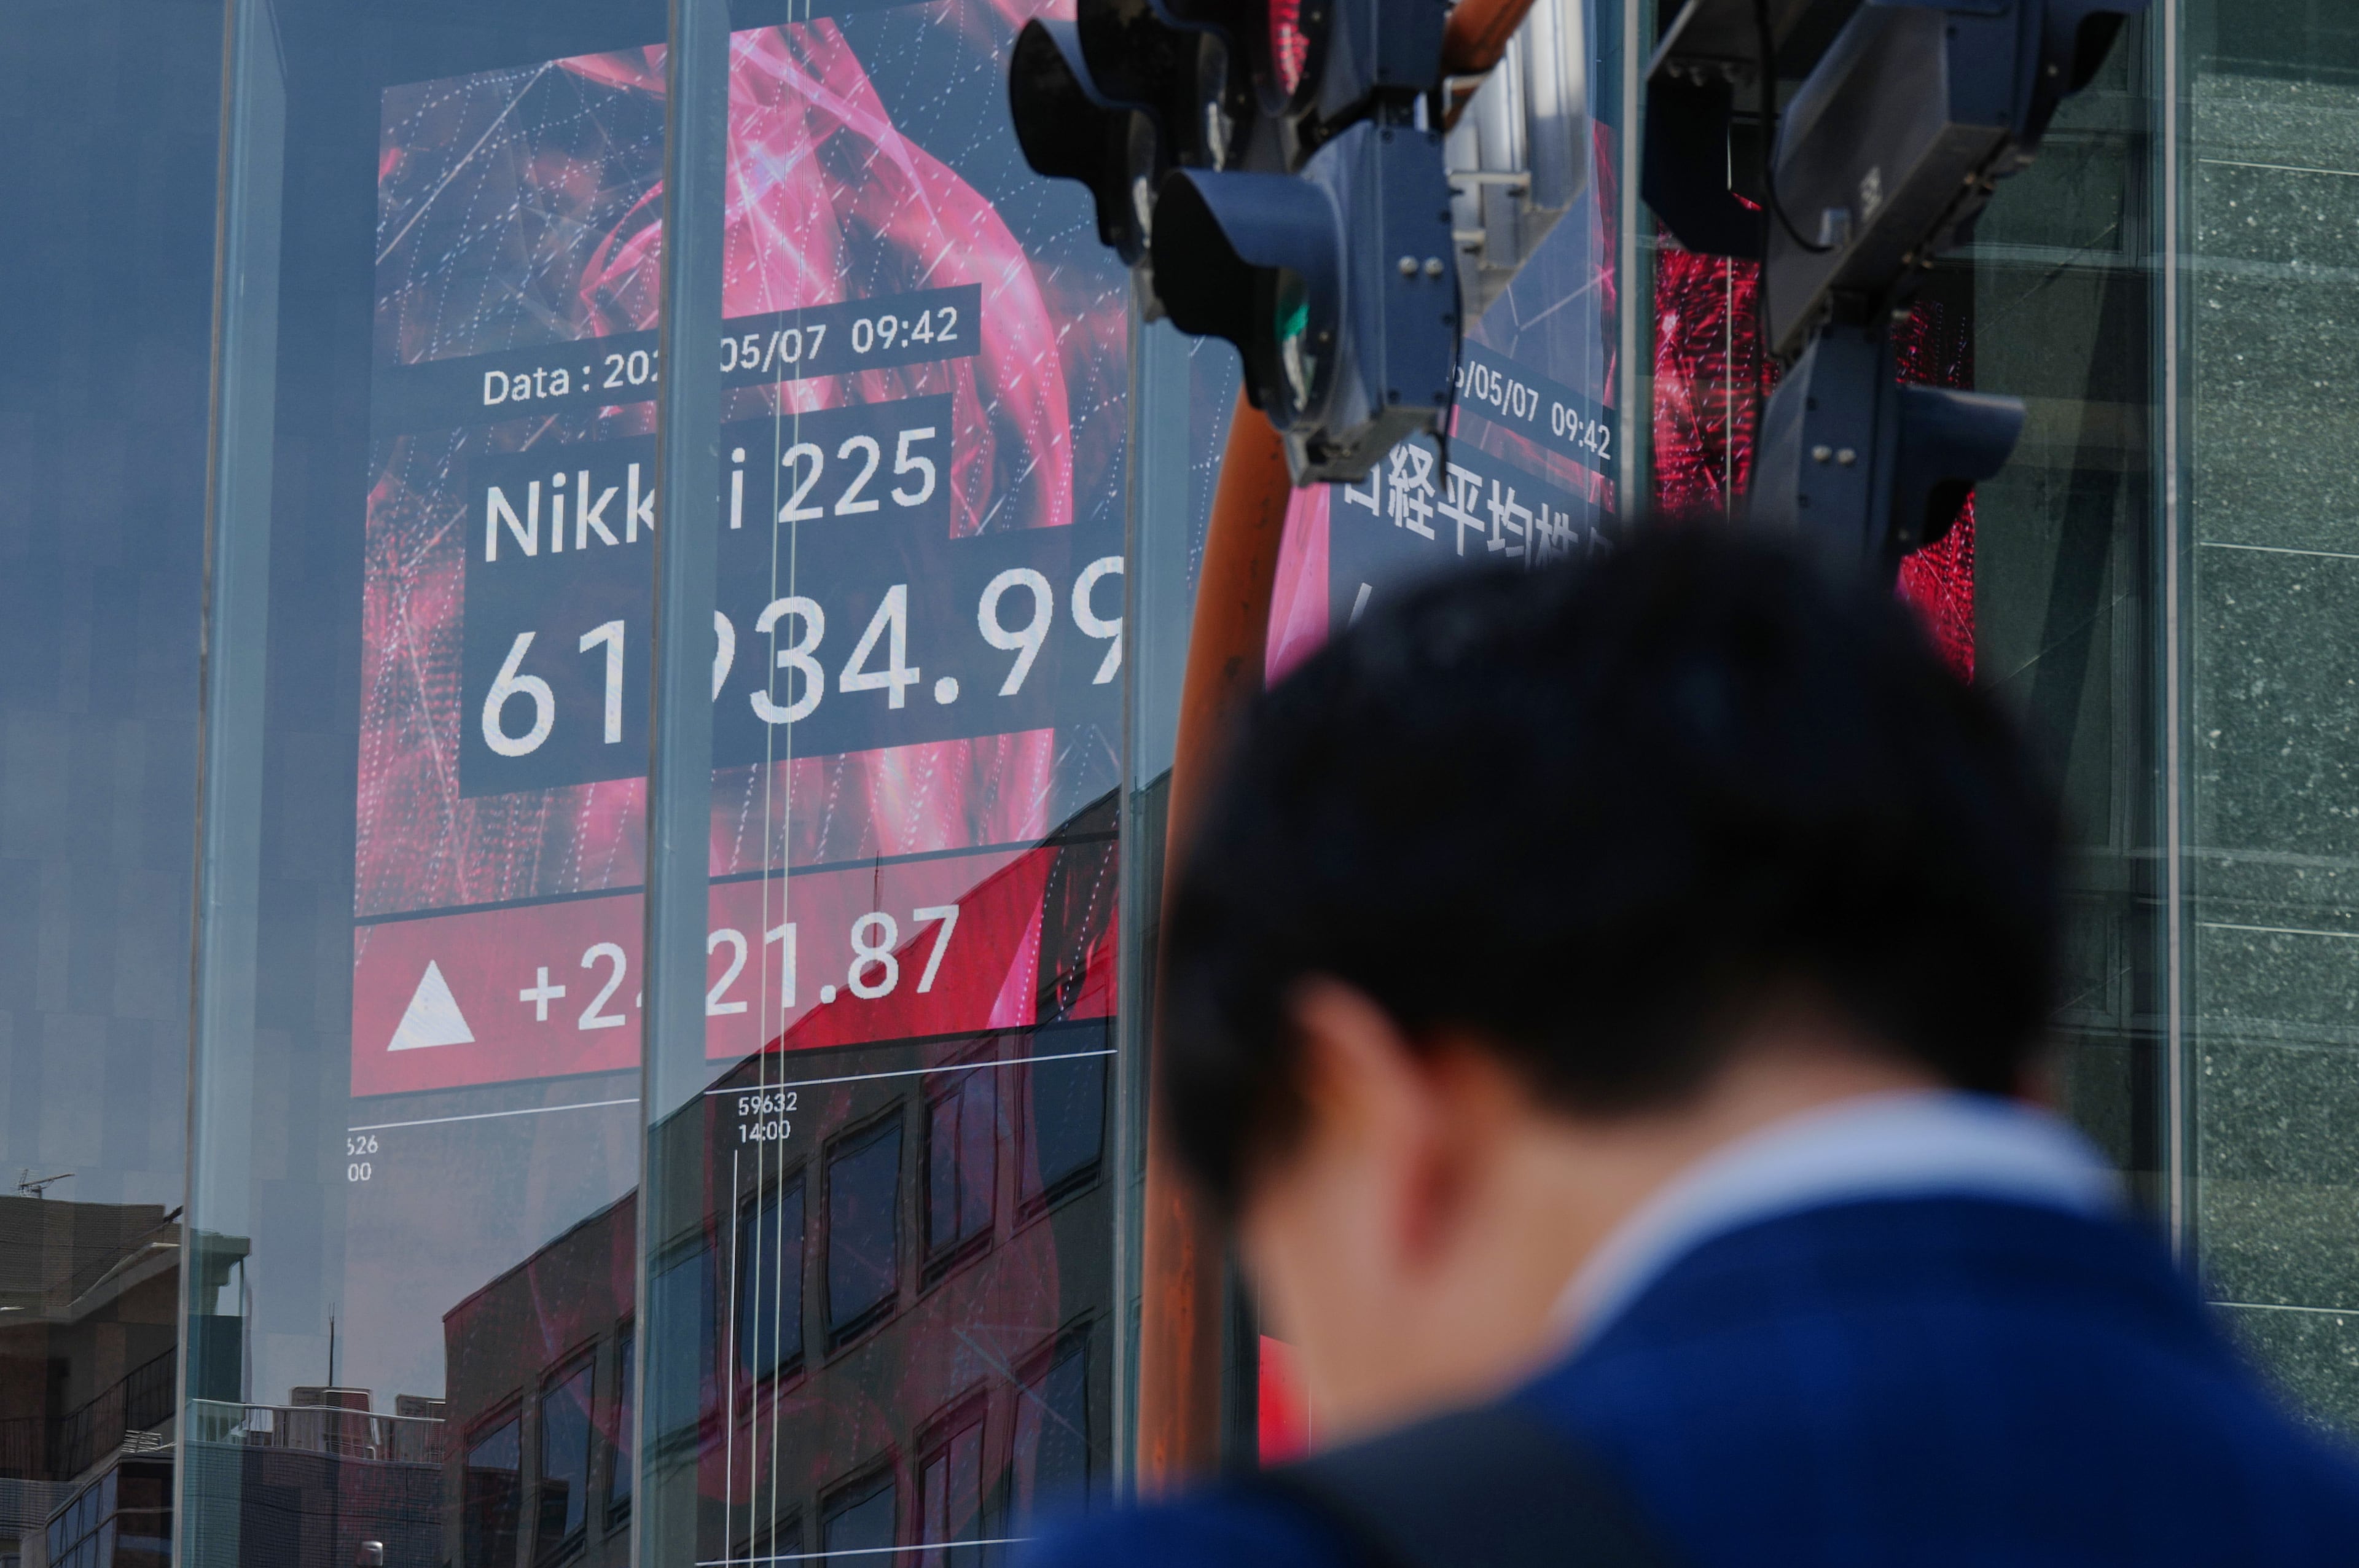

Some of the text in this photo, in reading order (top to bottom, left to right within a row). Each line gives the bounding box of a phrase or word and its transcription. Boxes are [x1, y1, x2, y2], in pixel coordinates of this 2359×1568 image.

[483, 367, 569, 405] Data
[851, 306, 958, 354] 09:42
[1551, 402, 1611, 460] 09:42
[485, 426, 936, 563] Nikki 225
[519, 904, 960, 1030] +221.87
[738, 1092, 797, 1116] 59632
[738, 1120, 791, 1143] 14:00
